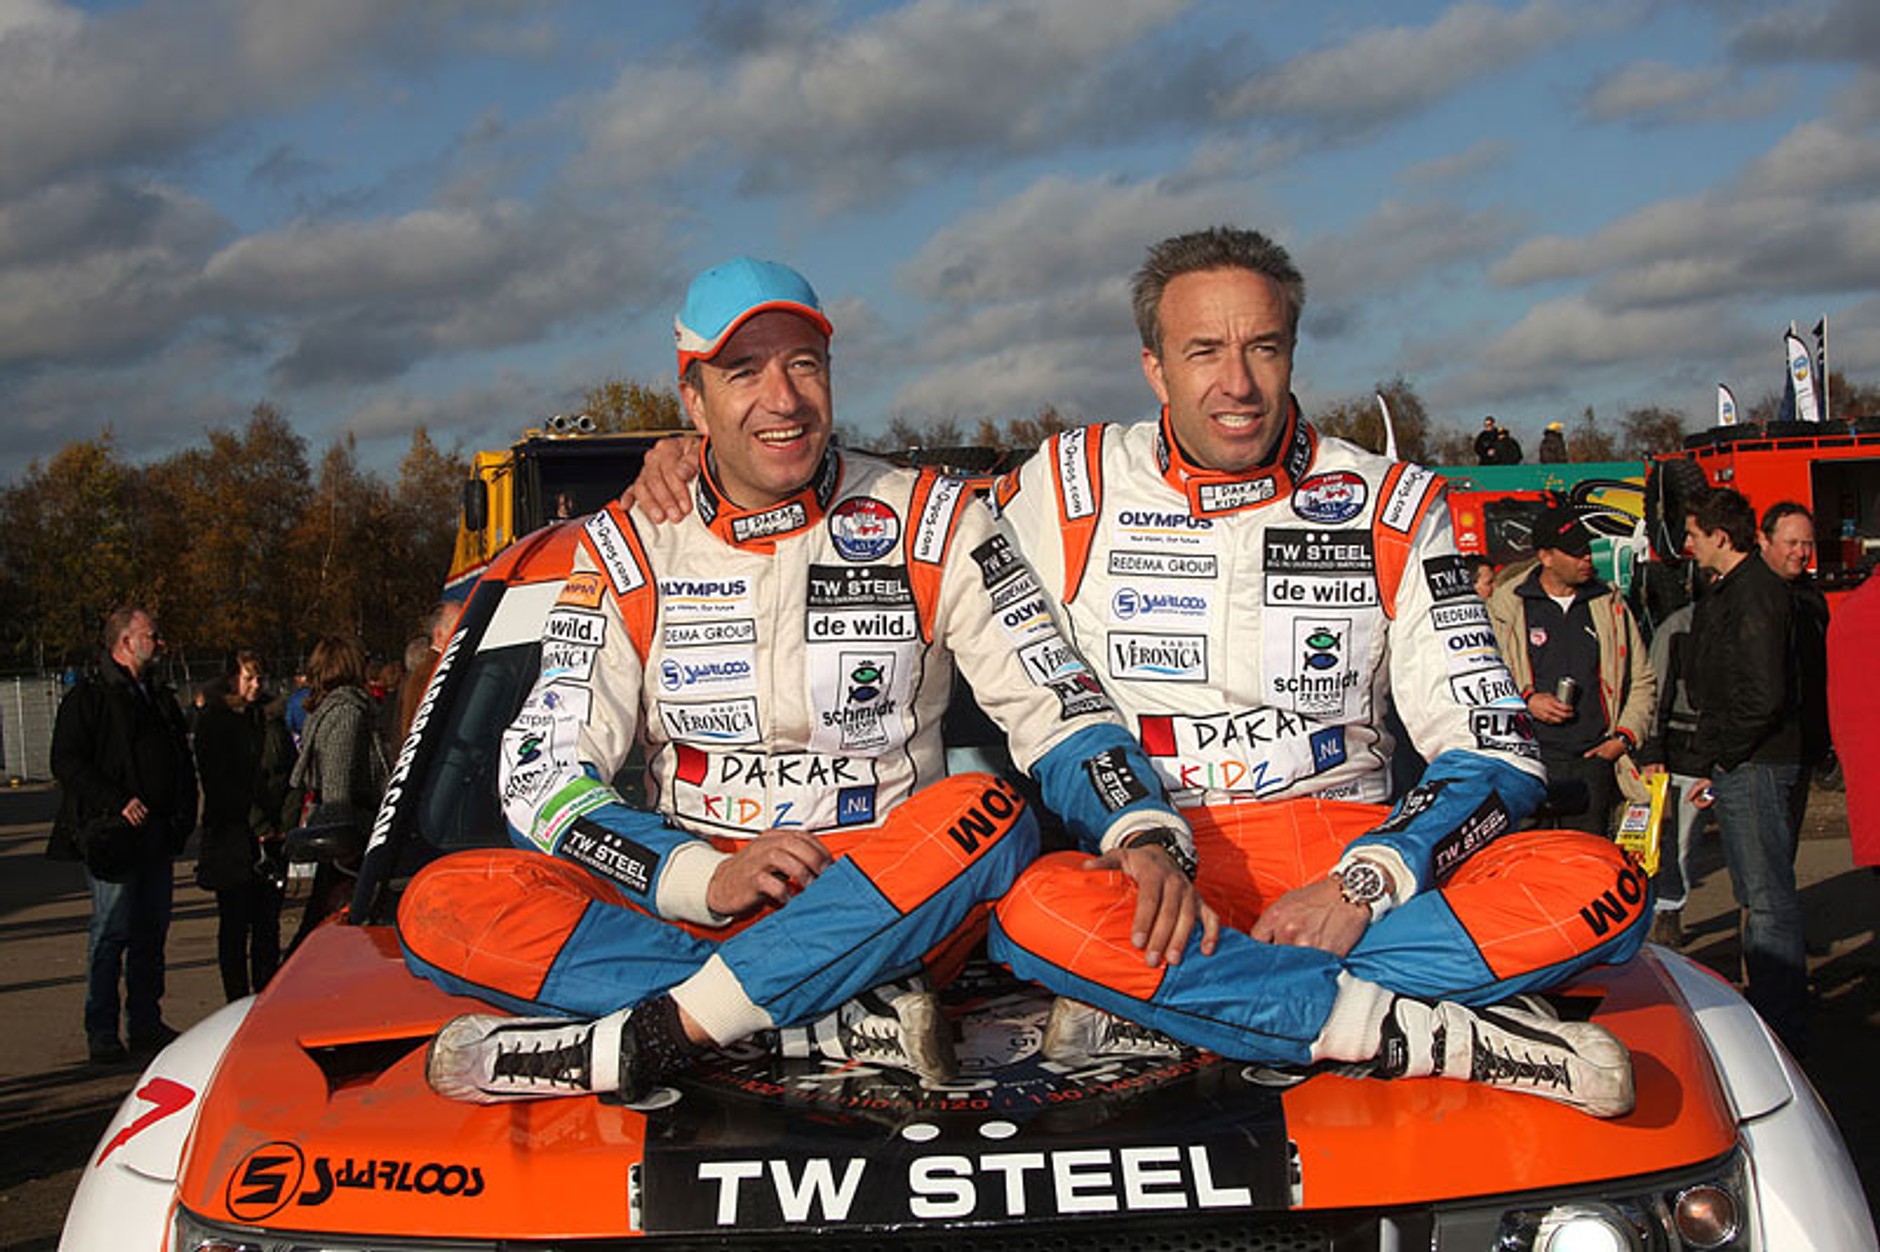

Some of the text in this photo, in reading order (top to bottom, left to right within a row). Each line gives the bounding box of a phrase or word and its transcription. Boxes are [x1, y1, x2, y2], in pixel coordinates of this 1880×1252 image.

[1118, 511, 1214, 529] OLYMPUS
[1268, 544, 1372, 560] TW STEEL
[1114, 556, 1215, 573] REDEMA GROUP
[810, 579, 909, 596] TW STEEL
[1273, 579, 1374, 602] de wild.
[551, 617, 599, 641] wild.
[705, 625, 754, 640] GROUP
[813, 614, 912, 636] de wild.
[1274, 671, 1359, 692] schmidt
[822, 701, 896, 727] schmidt
[722, 756, 858, 788] DAKAR
[1181, 761, 1283, 790] KIDZ
[703, 794, 803, 828] KIDZ
[843, 797, 870, 814] .NL
[570, 831, 648, 883] TW STEEL
[698, 1146, 1253, 1226] TW STEEL
